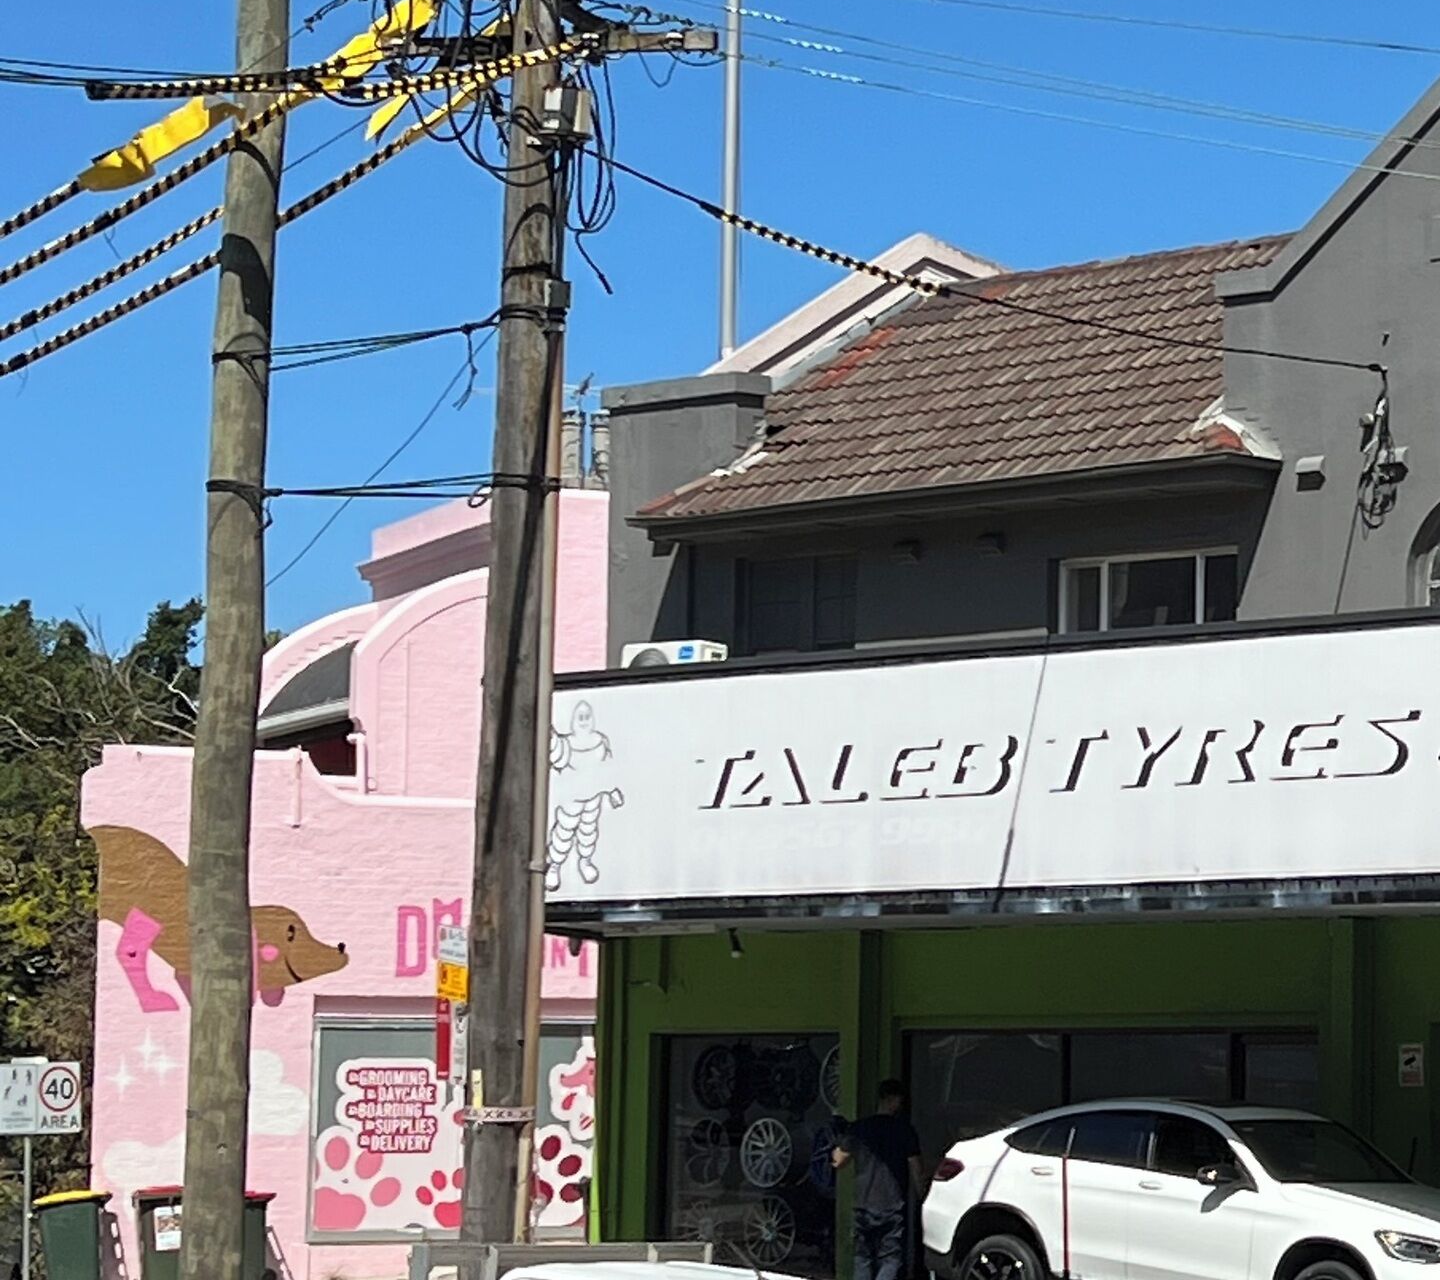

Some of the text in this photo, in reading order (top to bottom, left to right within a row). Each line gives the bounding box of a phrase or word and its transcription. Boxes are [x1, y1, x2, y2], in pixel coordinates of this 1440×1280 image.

[696, 734, 1019, 810] TALEB
[1046, 709, 1422, 794] TYRES
[359, 1069, 427, 1086] GROOMING
[45, 1077, 74, 1100] 40
[378, 1085, 436, 1102] DAYCARE
[357, 1102, 423, 1118] BOARDING
[41, 1114, 79, 1129] AREA
[374, 1118, 436, 1135] SUPPLIES
[369, 1134, 430, 1151] DELIVERY
